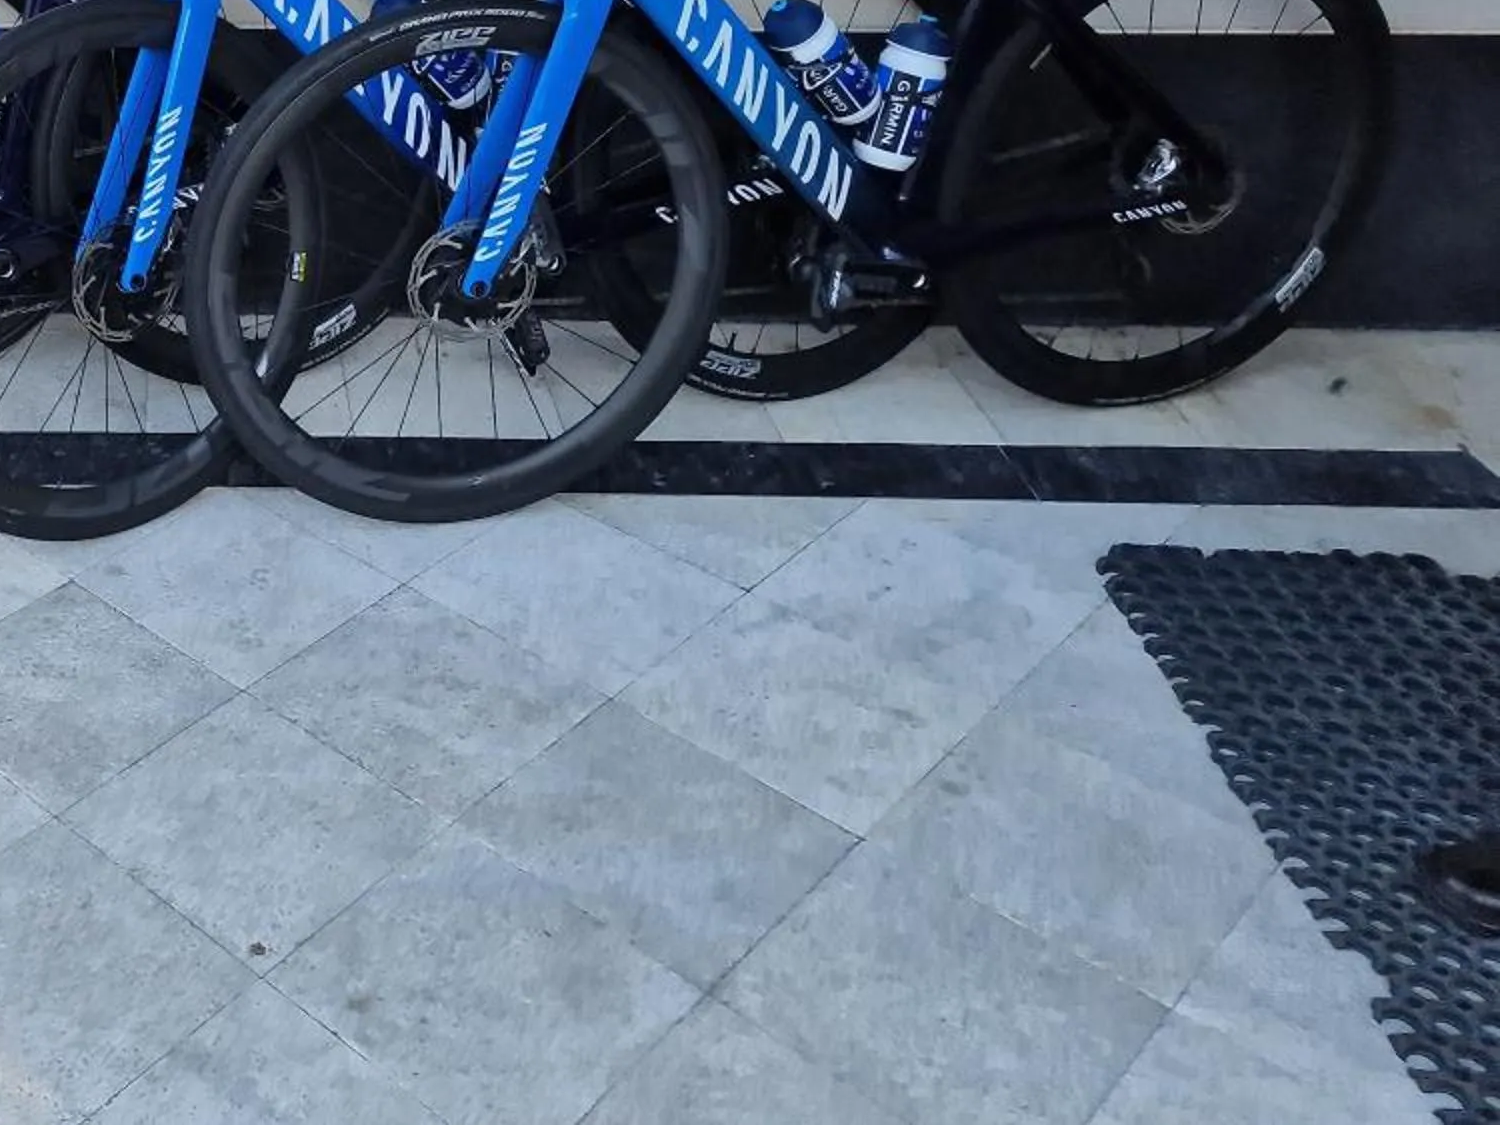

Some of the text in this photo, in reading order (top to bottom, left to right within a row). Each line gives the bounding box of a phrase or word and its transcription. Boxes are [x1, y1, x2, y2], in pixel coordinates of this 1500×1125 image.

[134, 105, 182, 243] CANYON
[474, 122, 548, 263] CANYON
[1112, 199, 1187, 224] CANYON
